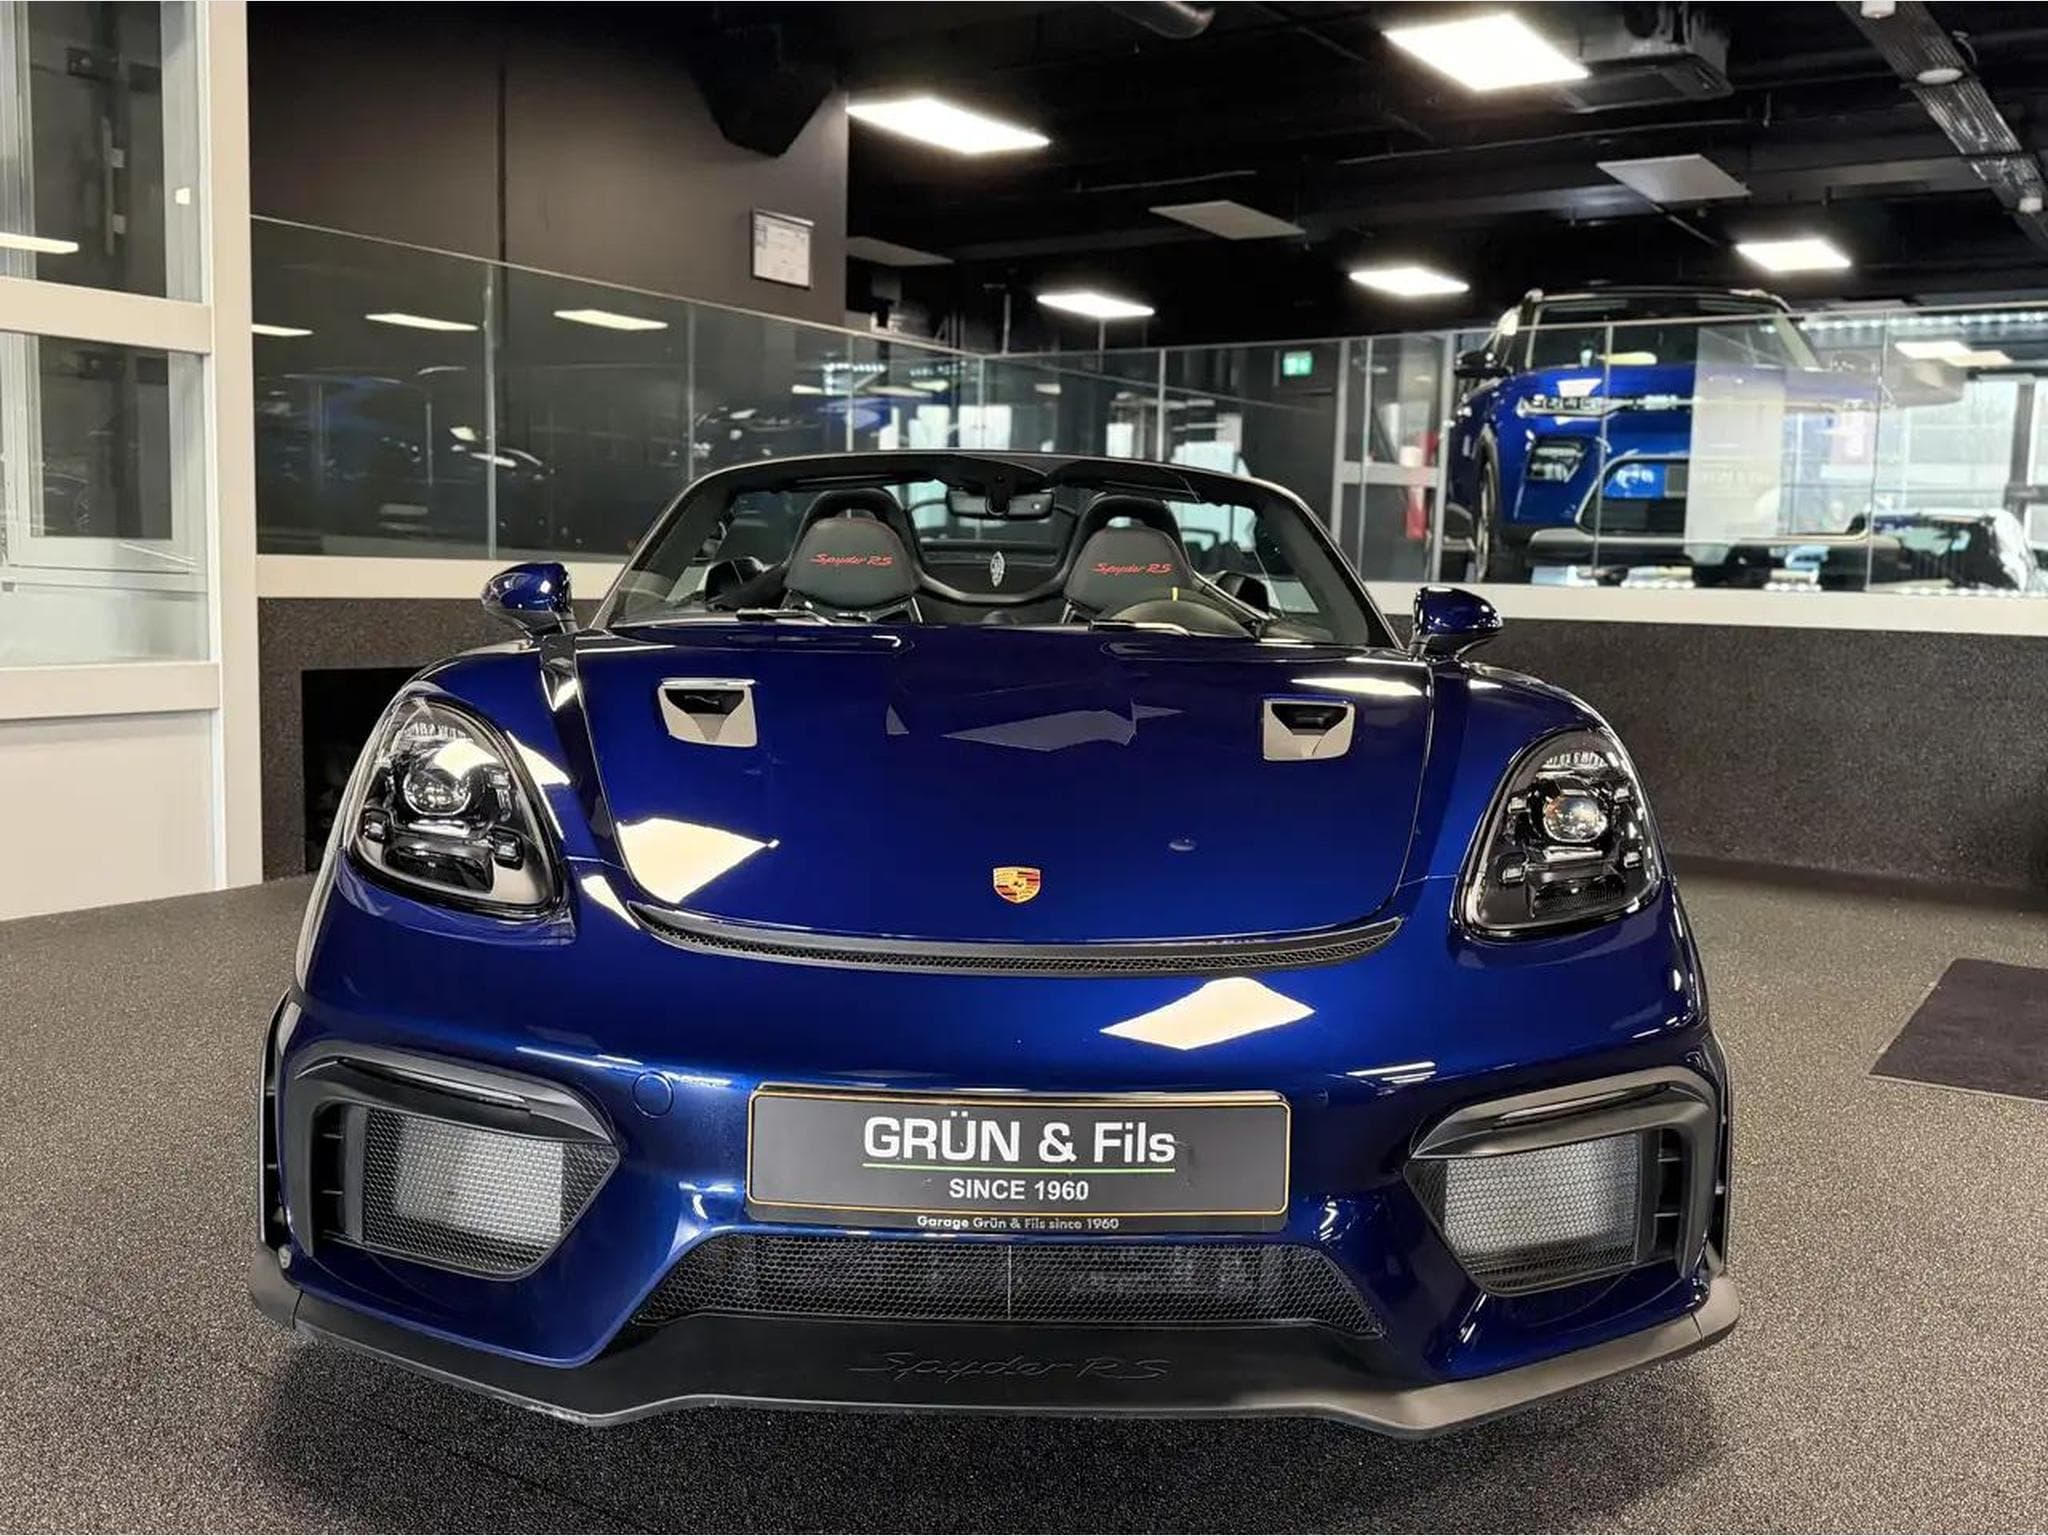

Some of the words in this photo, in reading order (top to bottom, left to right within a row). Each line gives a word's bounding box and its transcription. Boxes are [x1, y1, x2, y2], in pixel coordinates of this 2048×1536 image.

[809, 553, 865, 566] Spyder
[866, 555, 894, 566] RS
[1091, 562, 1146, 576] Spyder
[1146, 562, 1174, 574] RS
[864, 1110, 1020, 1162] GRÜN
[1038, 1121, 1077, 1163] &
[1093, 1121, 1176, 1163] Fils
[948, 1178, 1026, 1199] SINCE
[1034, 1180, 1089, 1201] 1960
[916, 1215, 969, 1230] Garage
[973, 1216, 1007, 1229] Grün
[1010, 1218, 1021, 1229] &
[1024, 1217, 1046, 1229] Fils
[1049, 1217, 1083, 1229] since
[1087, 1217, 1120, 1229] 1960
[848, 1351, 1074, 1384] Spyder
[1075, 1357, 1171, 1380] RS
